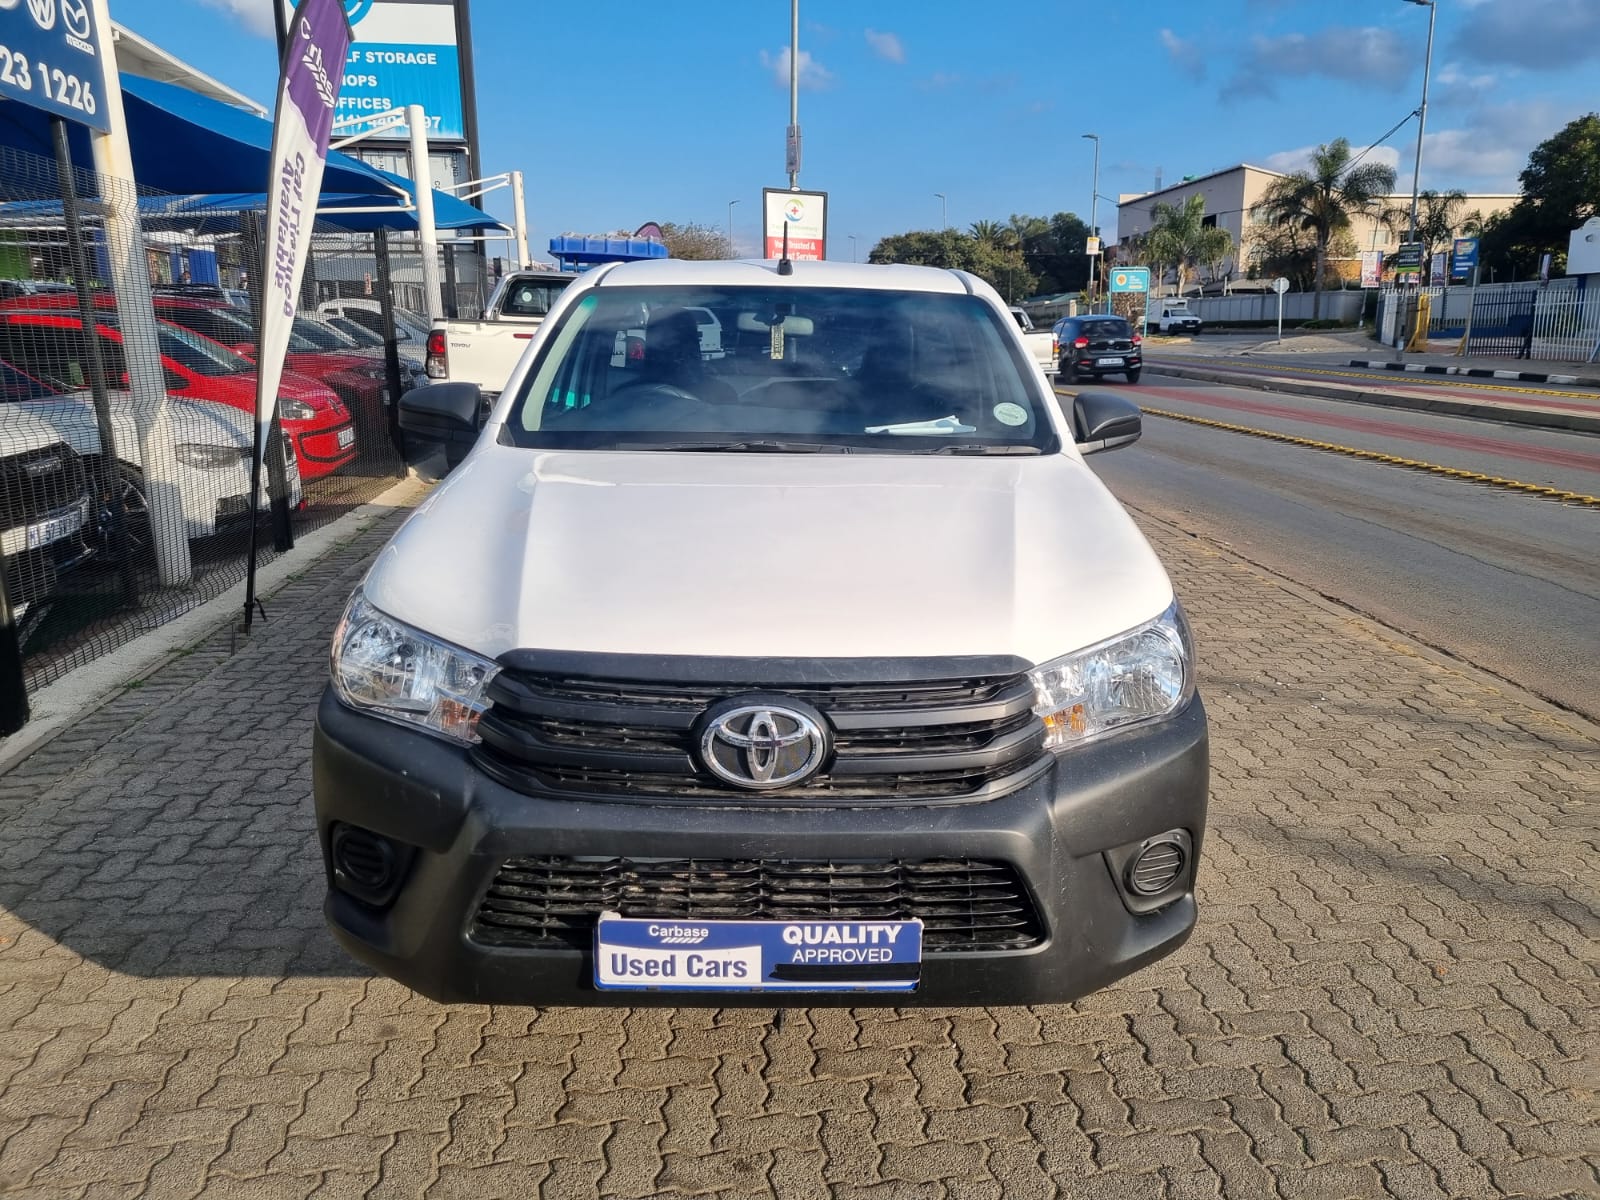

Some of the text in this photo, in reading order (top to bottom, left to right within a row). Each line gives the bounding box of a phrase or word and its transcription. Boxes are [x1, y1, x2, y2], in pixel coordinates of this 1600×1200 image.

[365, 51, 437, 65] STORAGE
[38, 62, 96, 115] 1226
[334, 97, 392, 109] FFICES
[293, 151, 306, 203] Car
[648, 924, 709, 938] Carbase
[782, 925, 902, 946] QUALITY
[792, 948, 893, 963] APPROVED
[610, 952, 749, 978] Used Cars
